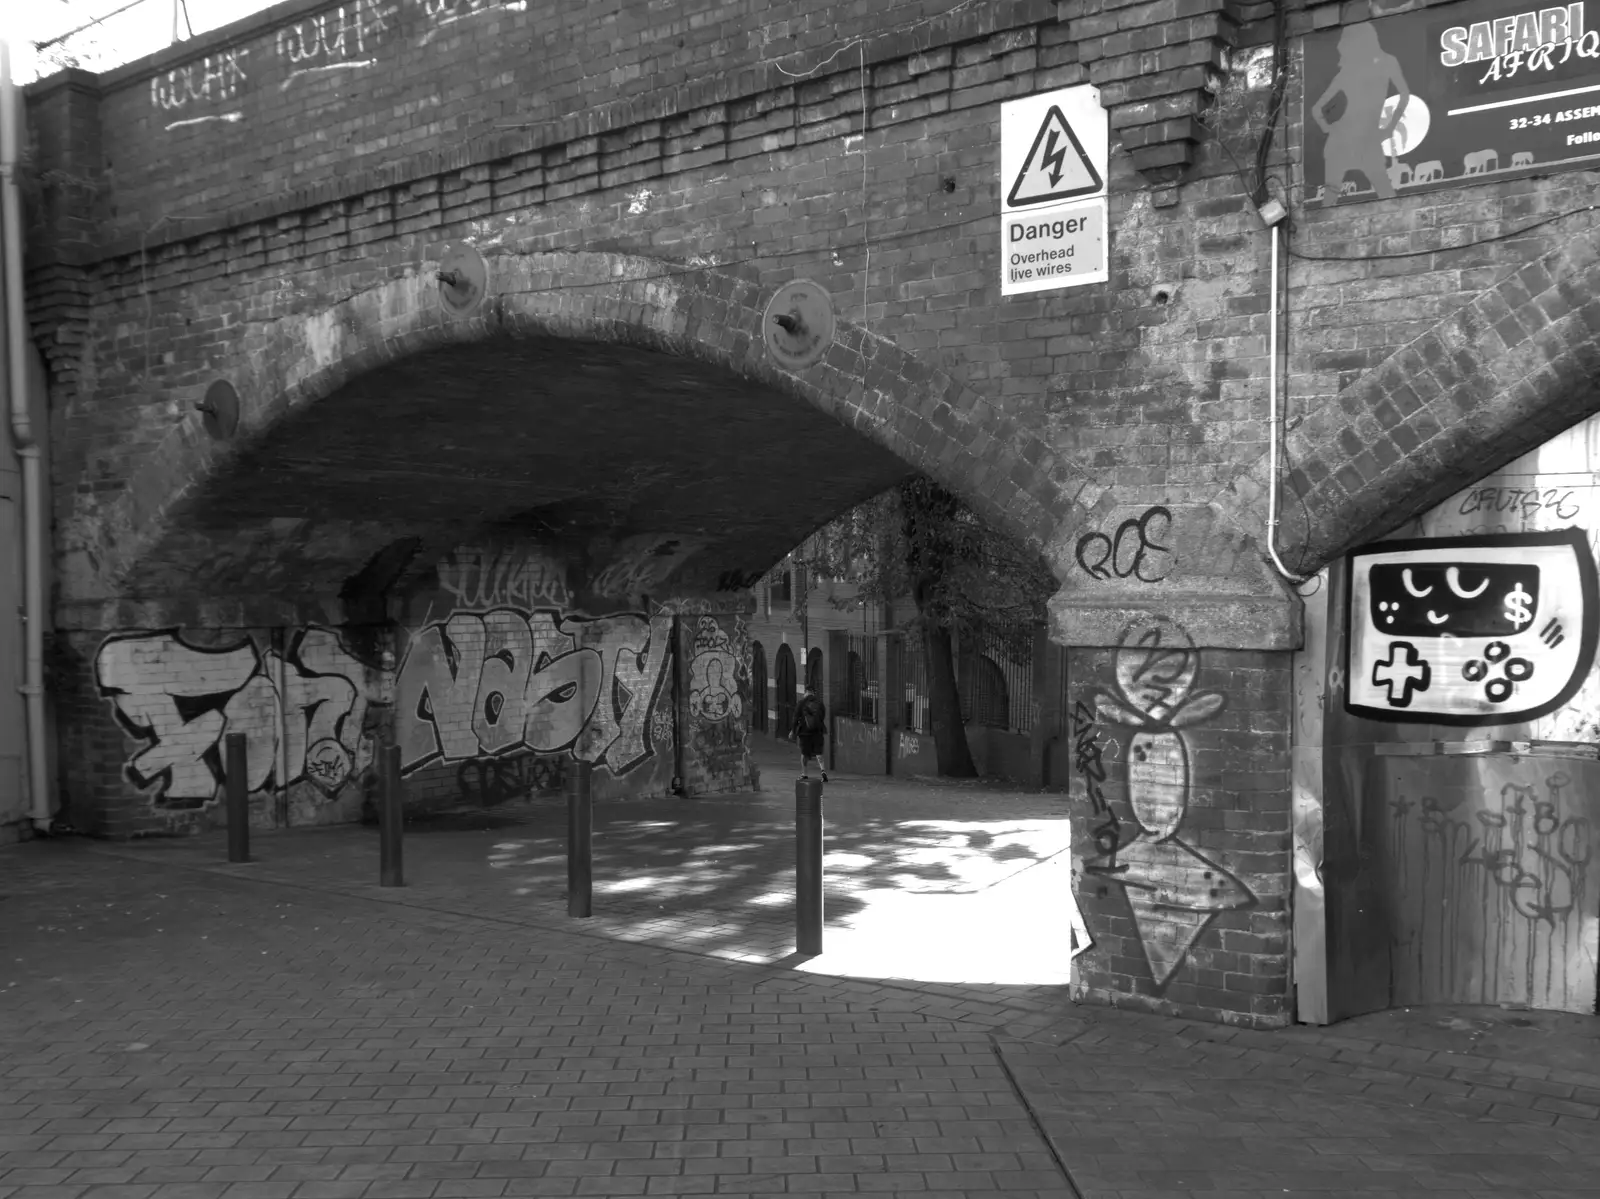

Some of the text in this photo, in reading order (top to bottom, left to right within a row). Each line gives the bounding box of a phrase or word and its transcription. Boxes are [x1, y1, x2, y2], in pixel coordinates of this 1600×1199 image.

[1440, 1, 1584, 67] SAFARI
[1509, 113, 1552, 130] 32-34
[1010, 216, 1087, 242] Danger
[1010, 244, 1075, 265] Overhead
[1010, 263, 1072, 282] live wires
